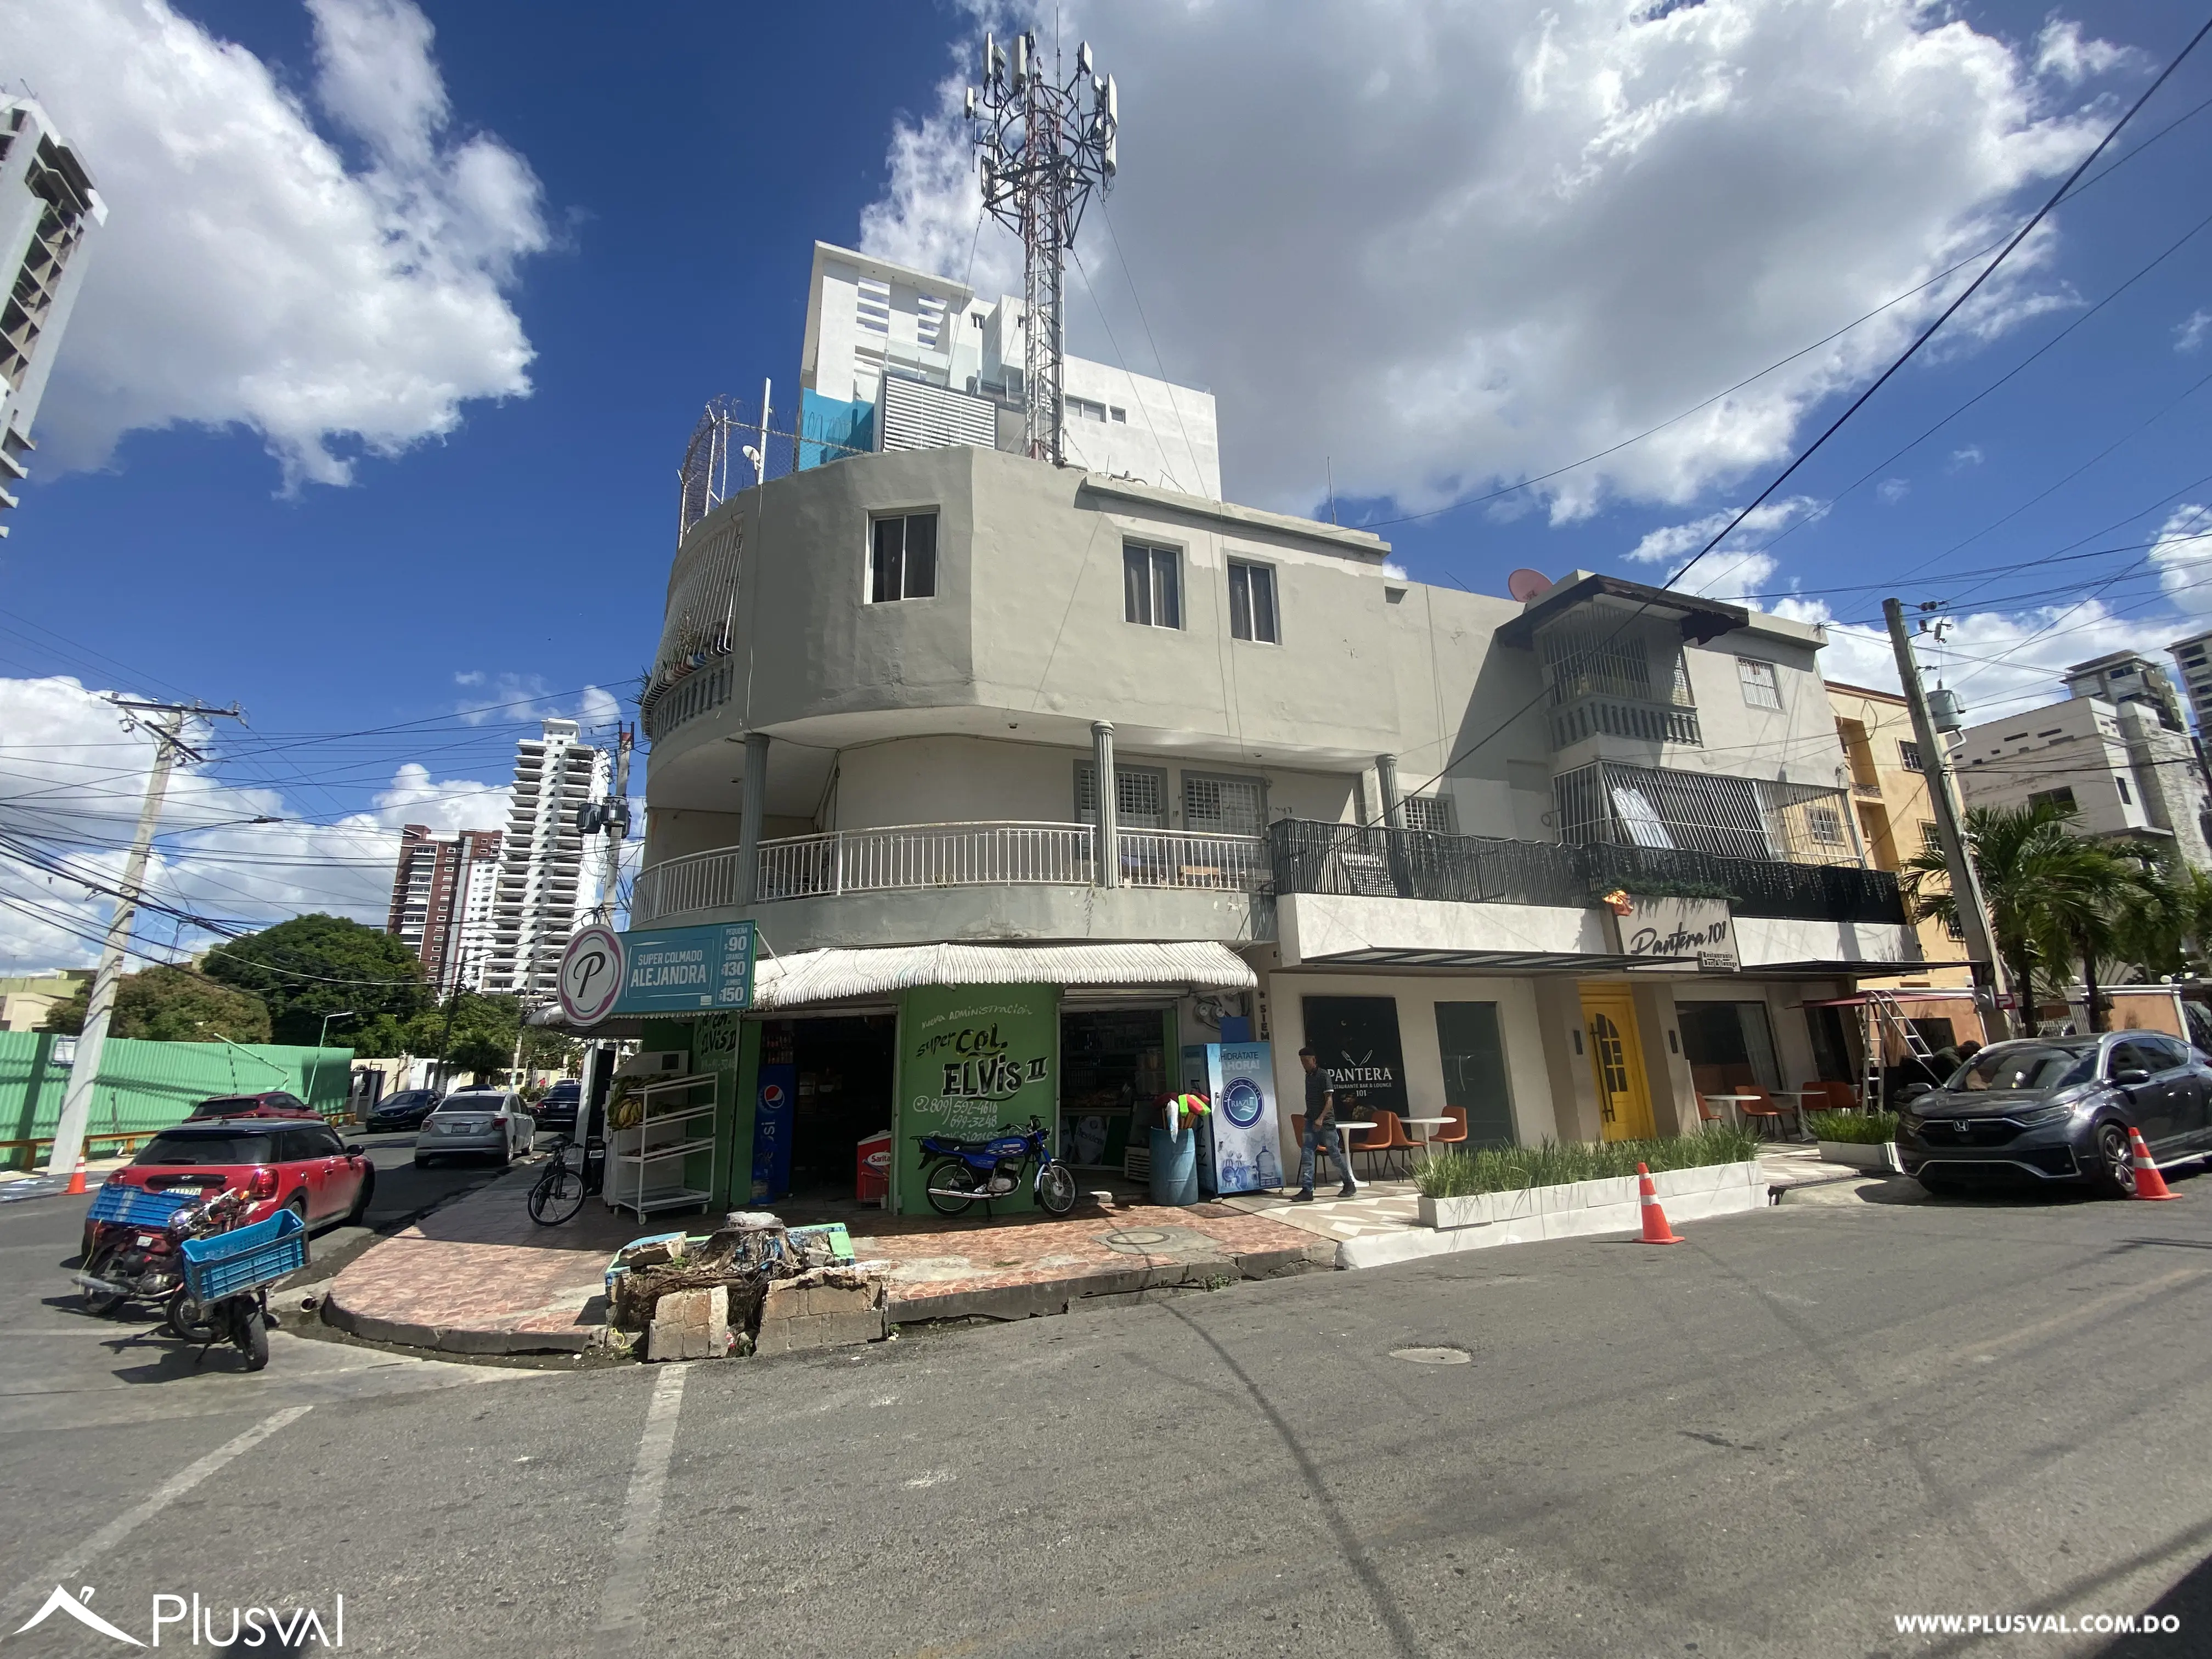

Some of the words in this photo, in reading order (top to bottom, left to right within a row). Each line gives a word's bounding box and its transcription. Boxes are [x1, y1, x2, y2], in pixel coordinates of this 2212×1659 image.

[724, 936, 747, 952] $90
[1630, 922, 1707, 956] Pantera
[1708, 921, 1726, 945] 101
[637, 952, 663, 966] SUPER
[664, 949, 703, 964] COLMADO
[630, 964, 707, 987] ALEJANDRA
[721, 961, 746, 977] $130
[719, 986, 744, 1002] $150
[1025, 1056, 1049, 1084] II
[1222, 1060, 1260, 1071] AHORA!
[1327, 1067, 1393, 1082] PANTERA
